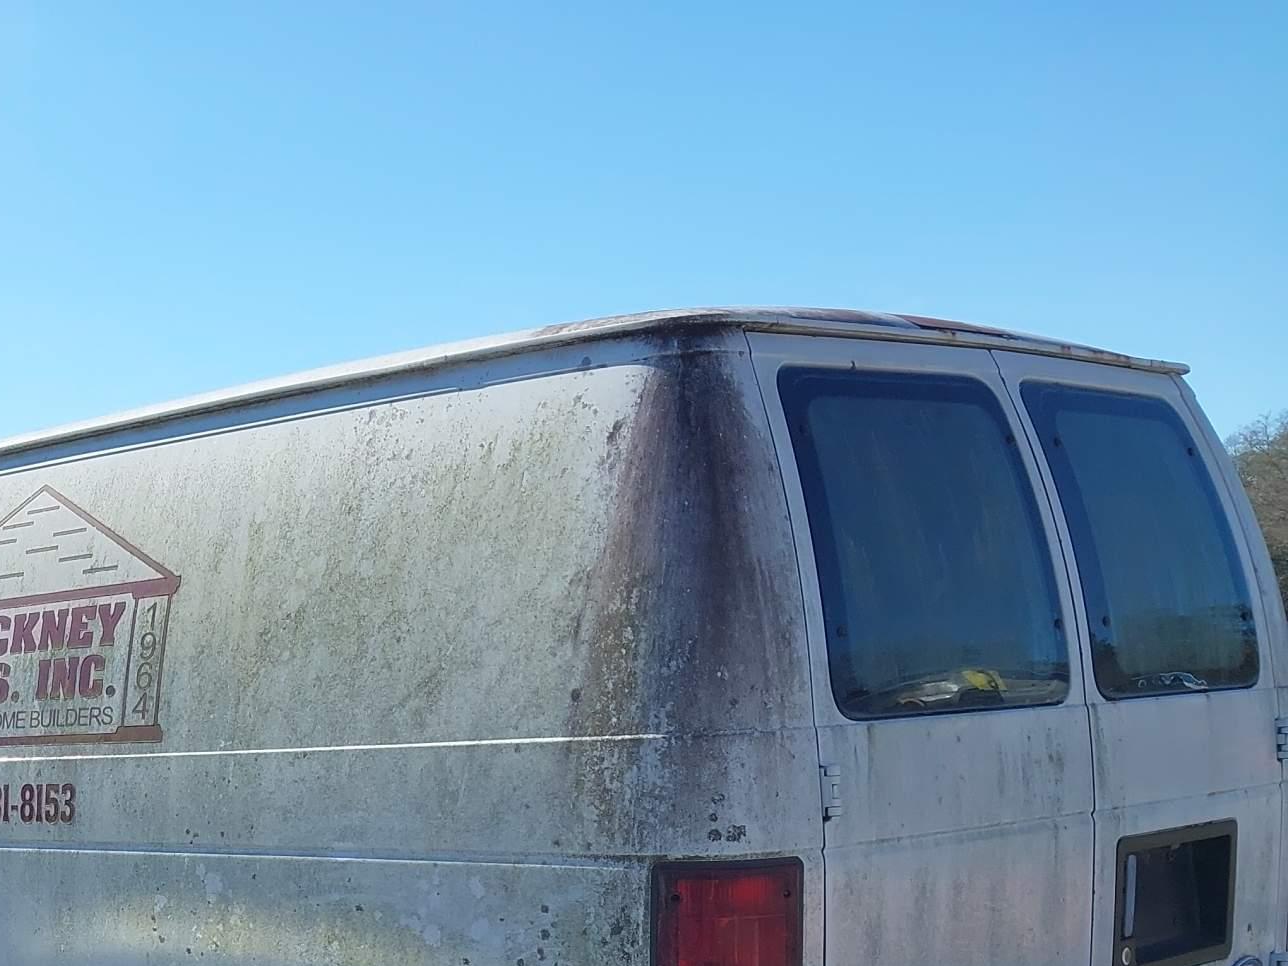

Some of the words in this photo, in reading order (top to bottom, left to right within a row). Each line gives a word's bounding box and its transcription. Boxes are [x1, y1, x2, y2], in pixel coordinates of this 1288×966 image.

[35, 654, 116, 701] INC.
[132, 602, 158, 721] 1964
[29, 706, 114, 729] BUILDERS
